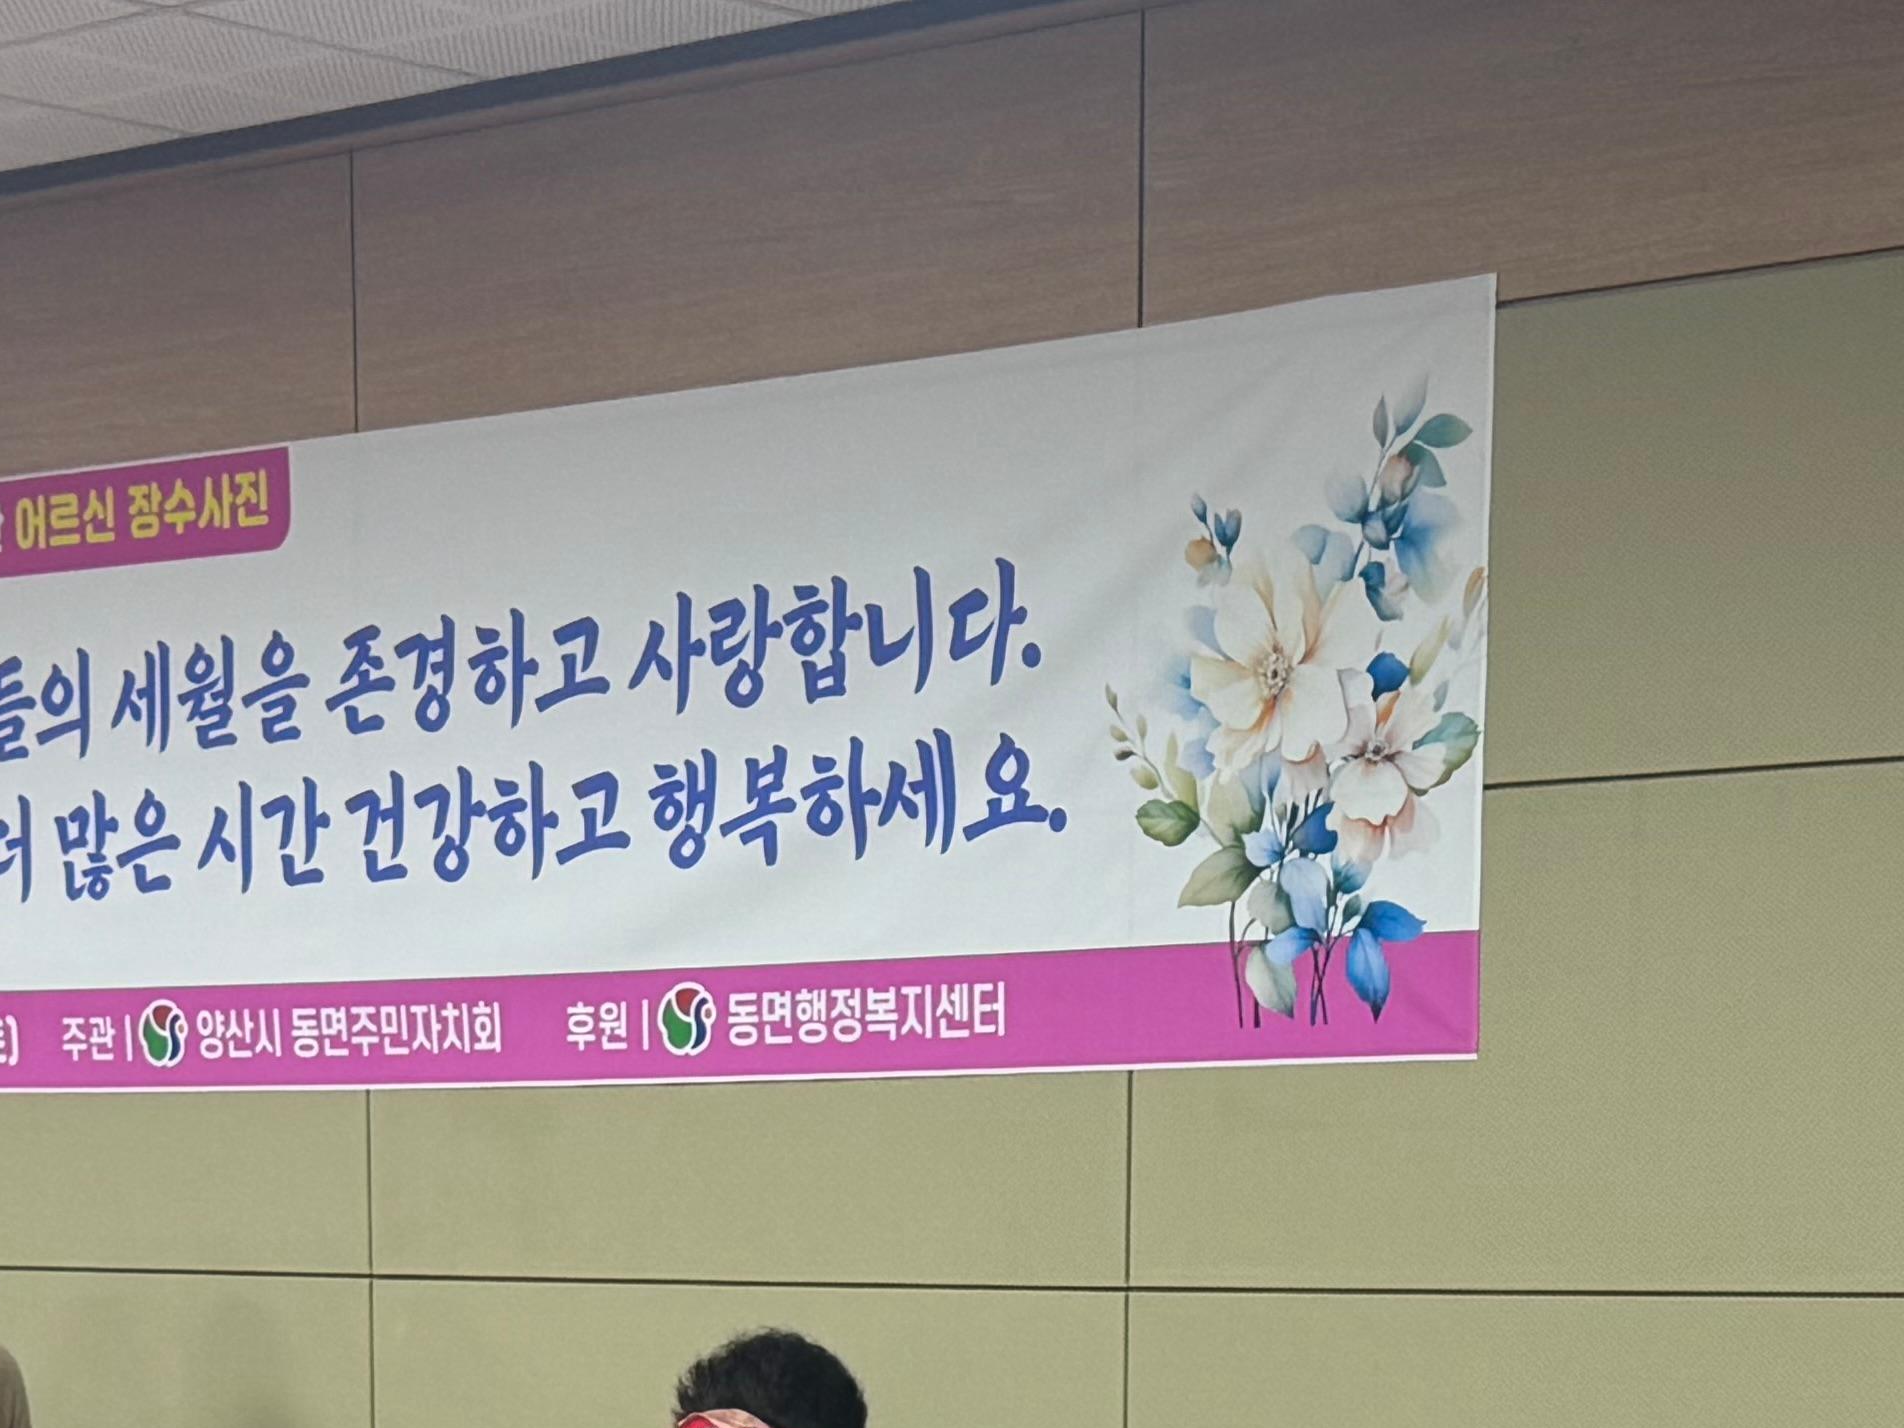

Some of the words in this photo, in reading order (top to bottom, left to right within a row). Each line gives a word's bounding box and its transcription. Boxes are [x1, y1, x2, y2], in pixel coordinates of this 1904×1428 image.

[16, 493, 113, 549] 어르신
[129, 473, 268, 539] 장수사진
[112, 633, 310, 754] 세월을
[326, 609, 611, 738] 존경하고
[628, 557, 1042, 713] 사랑합니다.
[53, 790, 182, 903] 많은
[196, 776, 333, 889] 시간
[346, 760, 633, 886] 건강하고
[646, 727, 1069, 869] 행복하세요.
[62, 1016, 116, 1062] 주관
[196, 1007, 282, 1060] 양산시
[291, 1000, 502, 1058] 동면주민자치회
[566, 1001, 628, 1051] 후원
[727, 981, 1006, 1047] 동면행정복지센터
